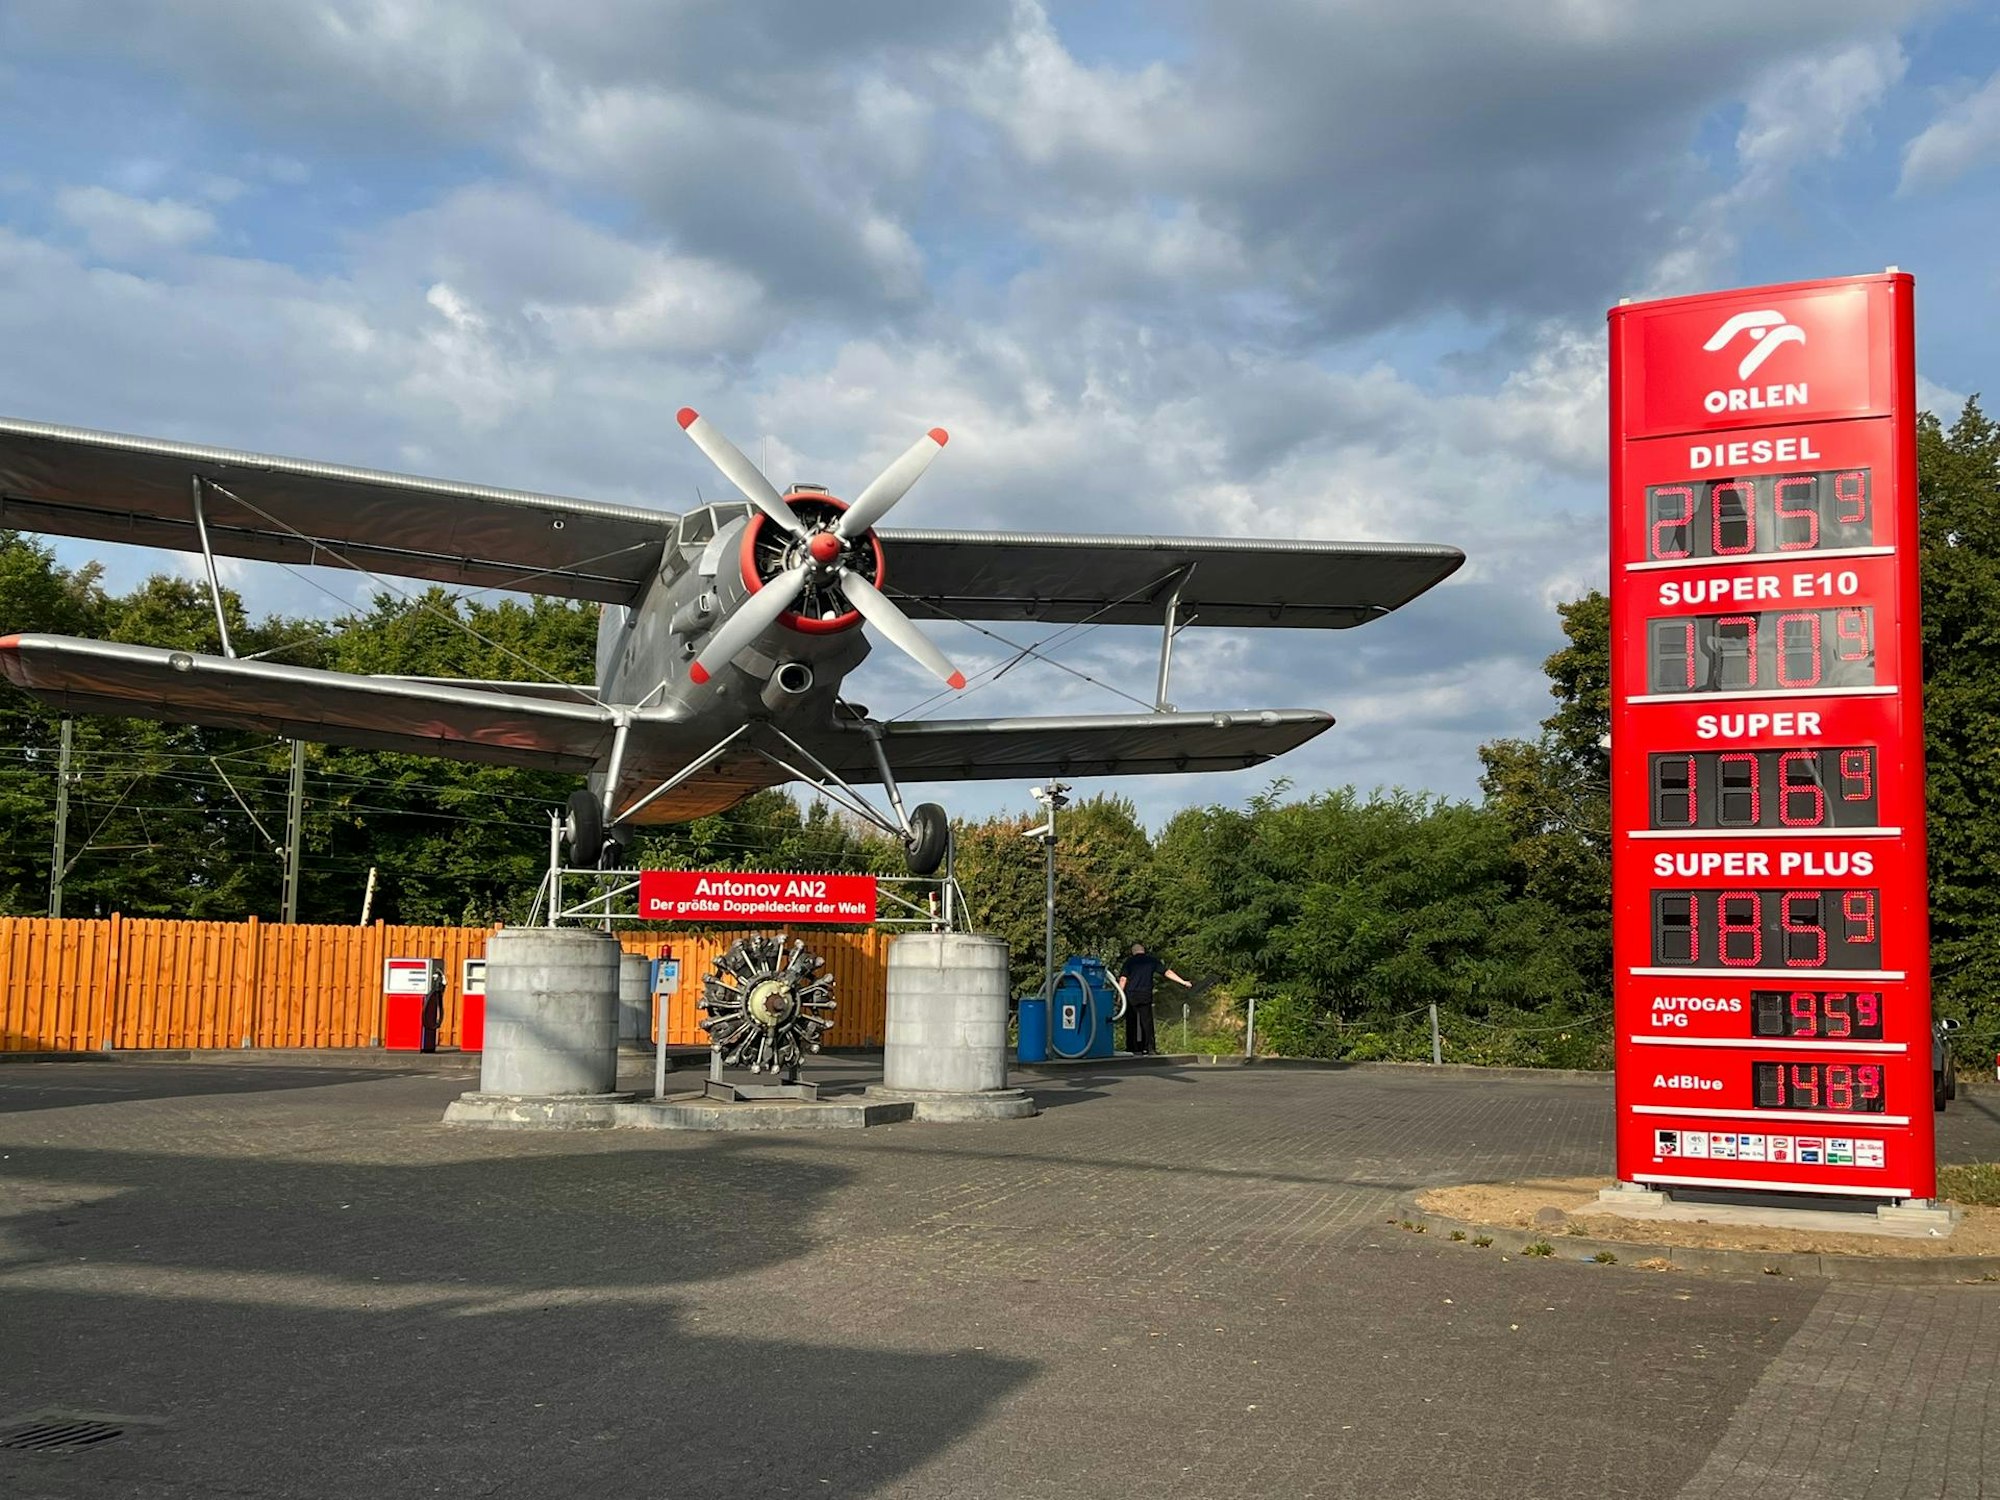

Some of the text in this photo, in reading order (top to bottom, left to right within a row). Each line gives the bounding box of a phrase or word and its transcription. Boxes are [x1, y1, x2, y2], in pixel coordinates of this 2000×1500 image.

[1704, 382, 1808, 413] ORLEN
[1689, 437, 1820, 469] DIESEL
[1659, 571, 1859, 606] SUPER E10
[1696, 711, 1822, 740] SUPER
[1653, 850, 1874, 877] SUPER PLUS
[694, 878, 827, 899] Antonov AN2
[650, 898, 867, 915] Der größte Doppeldecker der Welt
[1652, 996, 1742, 1012] AUTOGAS
[1651, 1013, 1689, 1027] LPG
[1653, 1074, 1724, 1091] AdBlue
